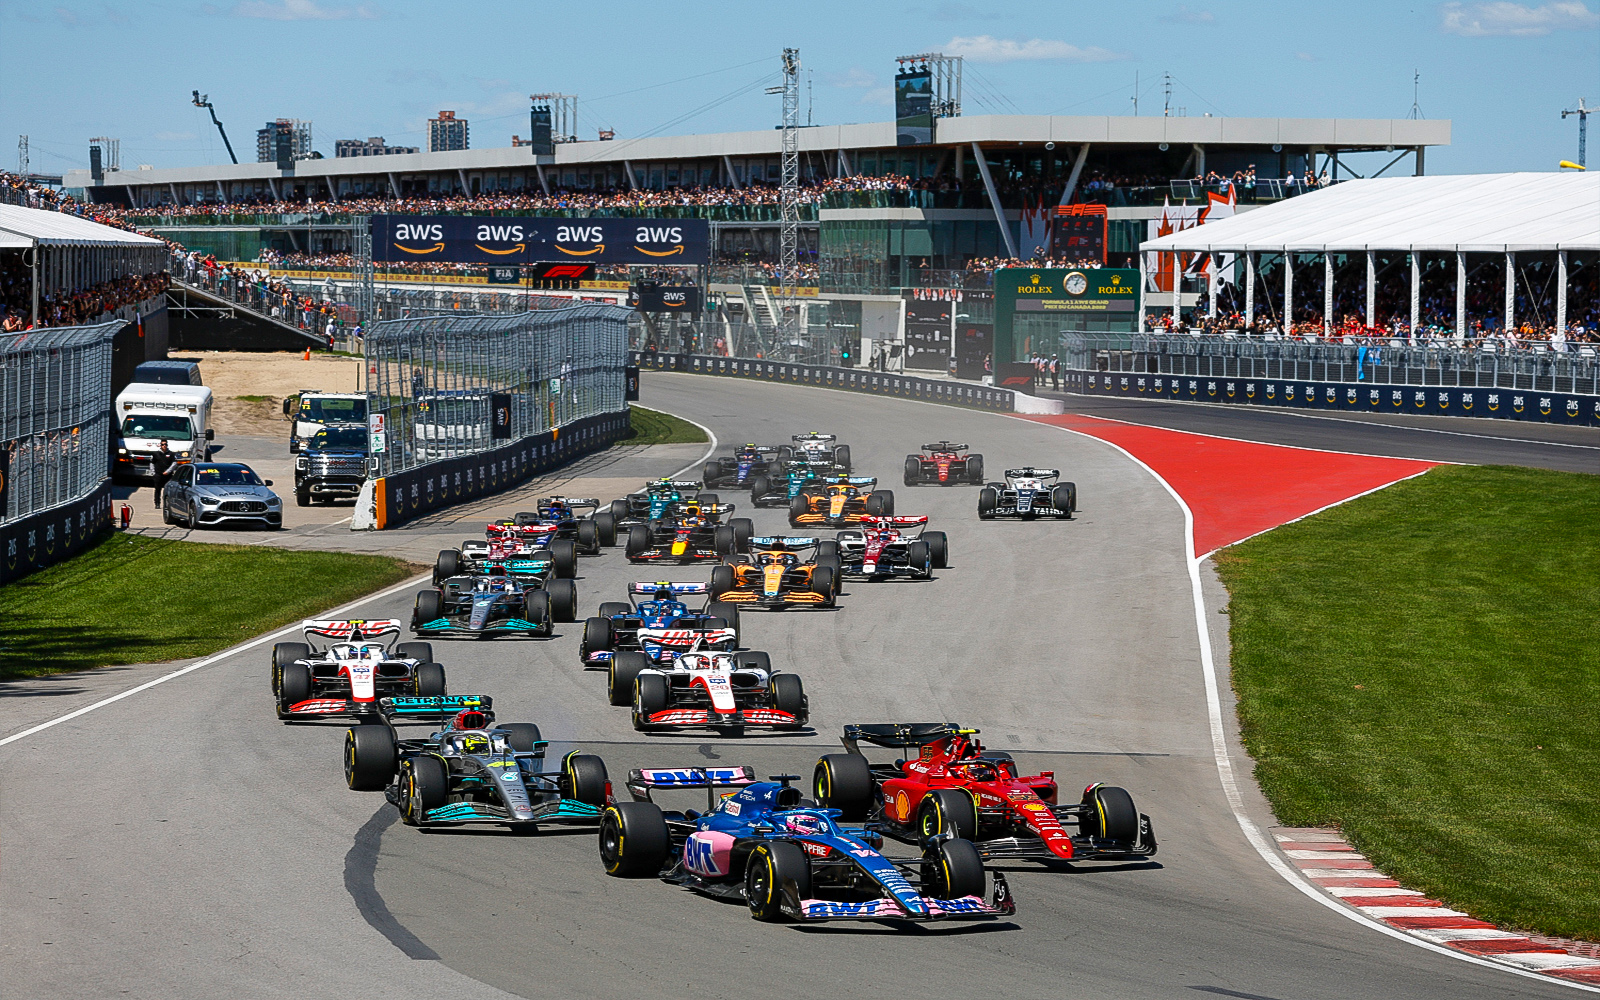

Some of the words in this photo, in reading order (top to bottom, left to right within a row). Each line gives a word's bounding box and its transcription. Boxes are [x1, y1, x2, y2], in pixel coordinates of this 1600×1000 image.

[395, 223, 443, 241] aws
[476, 224, 523, 242] aws
[556, 225, 603, 242] aws
[635, 226, 683, 243] aws
[495, 269, 512, 278] FIA
[1017, 286, 1053, 294] ROLEX
[1098, 286, 1133, 294] ROLEX
[663, 292, 686, 301] aws
[1462, 392, 1473, 402] aws
[1487, 393, 1499, 403] aws
[1513, 395, 1524, 405] aws
[1539, 397, 1551, 407] aws
[1566, 399, 1579, 410] aws
[395, 695, 476, 705] PETRONAS
[686, 836, 720, 874] BWT
[808, 899, 882, 917] BWT
